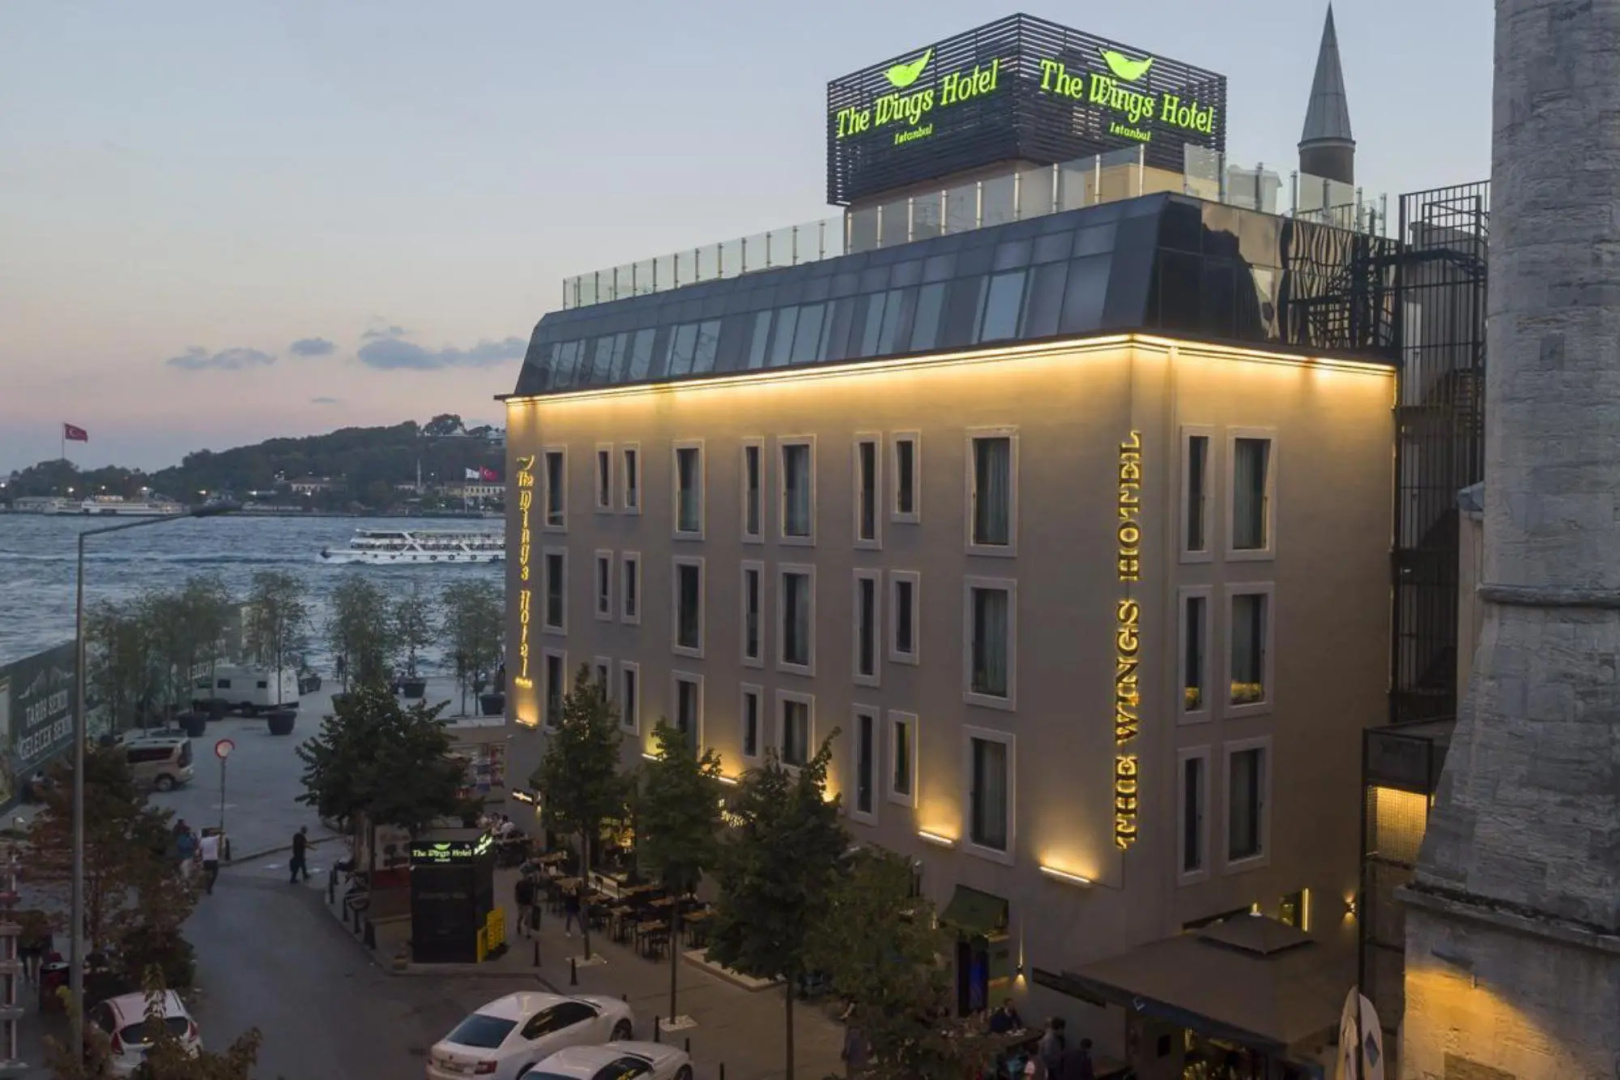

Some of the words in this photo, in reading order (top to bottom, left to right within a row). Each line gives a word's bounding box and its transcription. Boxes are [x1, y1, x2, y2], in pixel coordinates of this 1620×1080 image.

[836, 106, 871, 138] The
[874, 89, 935, 126] Wings
[940, 58, 999, 106] Hotel
[1039, 59, 1083, 99] The
[1089, 73, 1155, 123] Wings
[1160, 93, 1214, 133] Hotel
[1118, 430, 1143, 581] HOTEL
[1116, 600, 1140, 746] WINGS
[1115, 755, 1138, 850] THE
